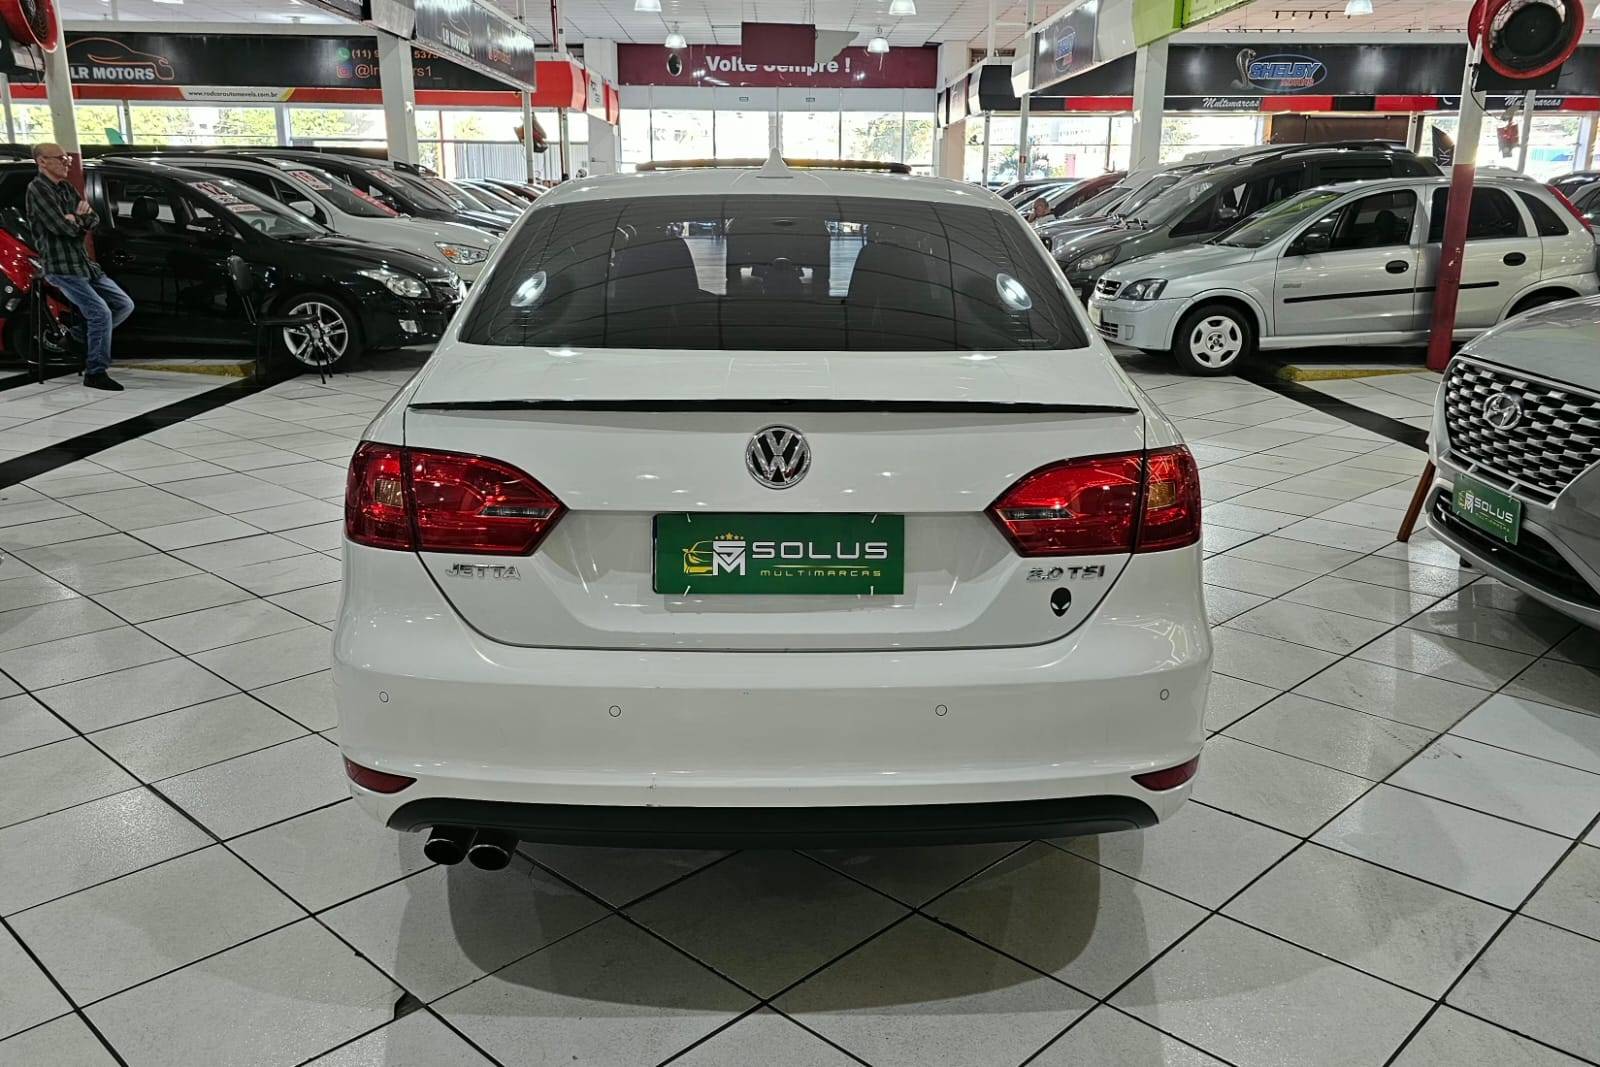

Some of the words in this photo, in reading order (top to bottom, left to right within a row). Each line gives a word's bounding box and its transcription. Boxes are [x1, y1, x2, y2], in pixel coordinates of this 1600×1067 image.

[352, 49, 371, 59] (11)
[705, 55, 757, 72] Volte
[1248, 62, 1321, 80] SHELBY
[70, 66, 89, 79] LR
[92, 67, 155, 80] MOTORS
[1202, 97, 1260, 109] Multimarcas
[1474, 497, 1514, 524] SOLUS
[752, 541, 888, 559] SOLUS
[445, 563, 521, 579] JETTA
[760, 569, 881, 577] MULTIMARCAS
[1067, 565, 1105, 579] TSI
